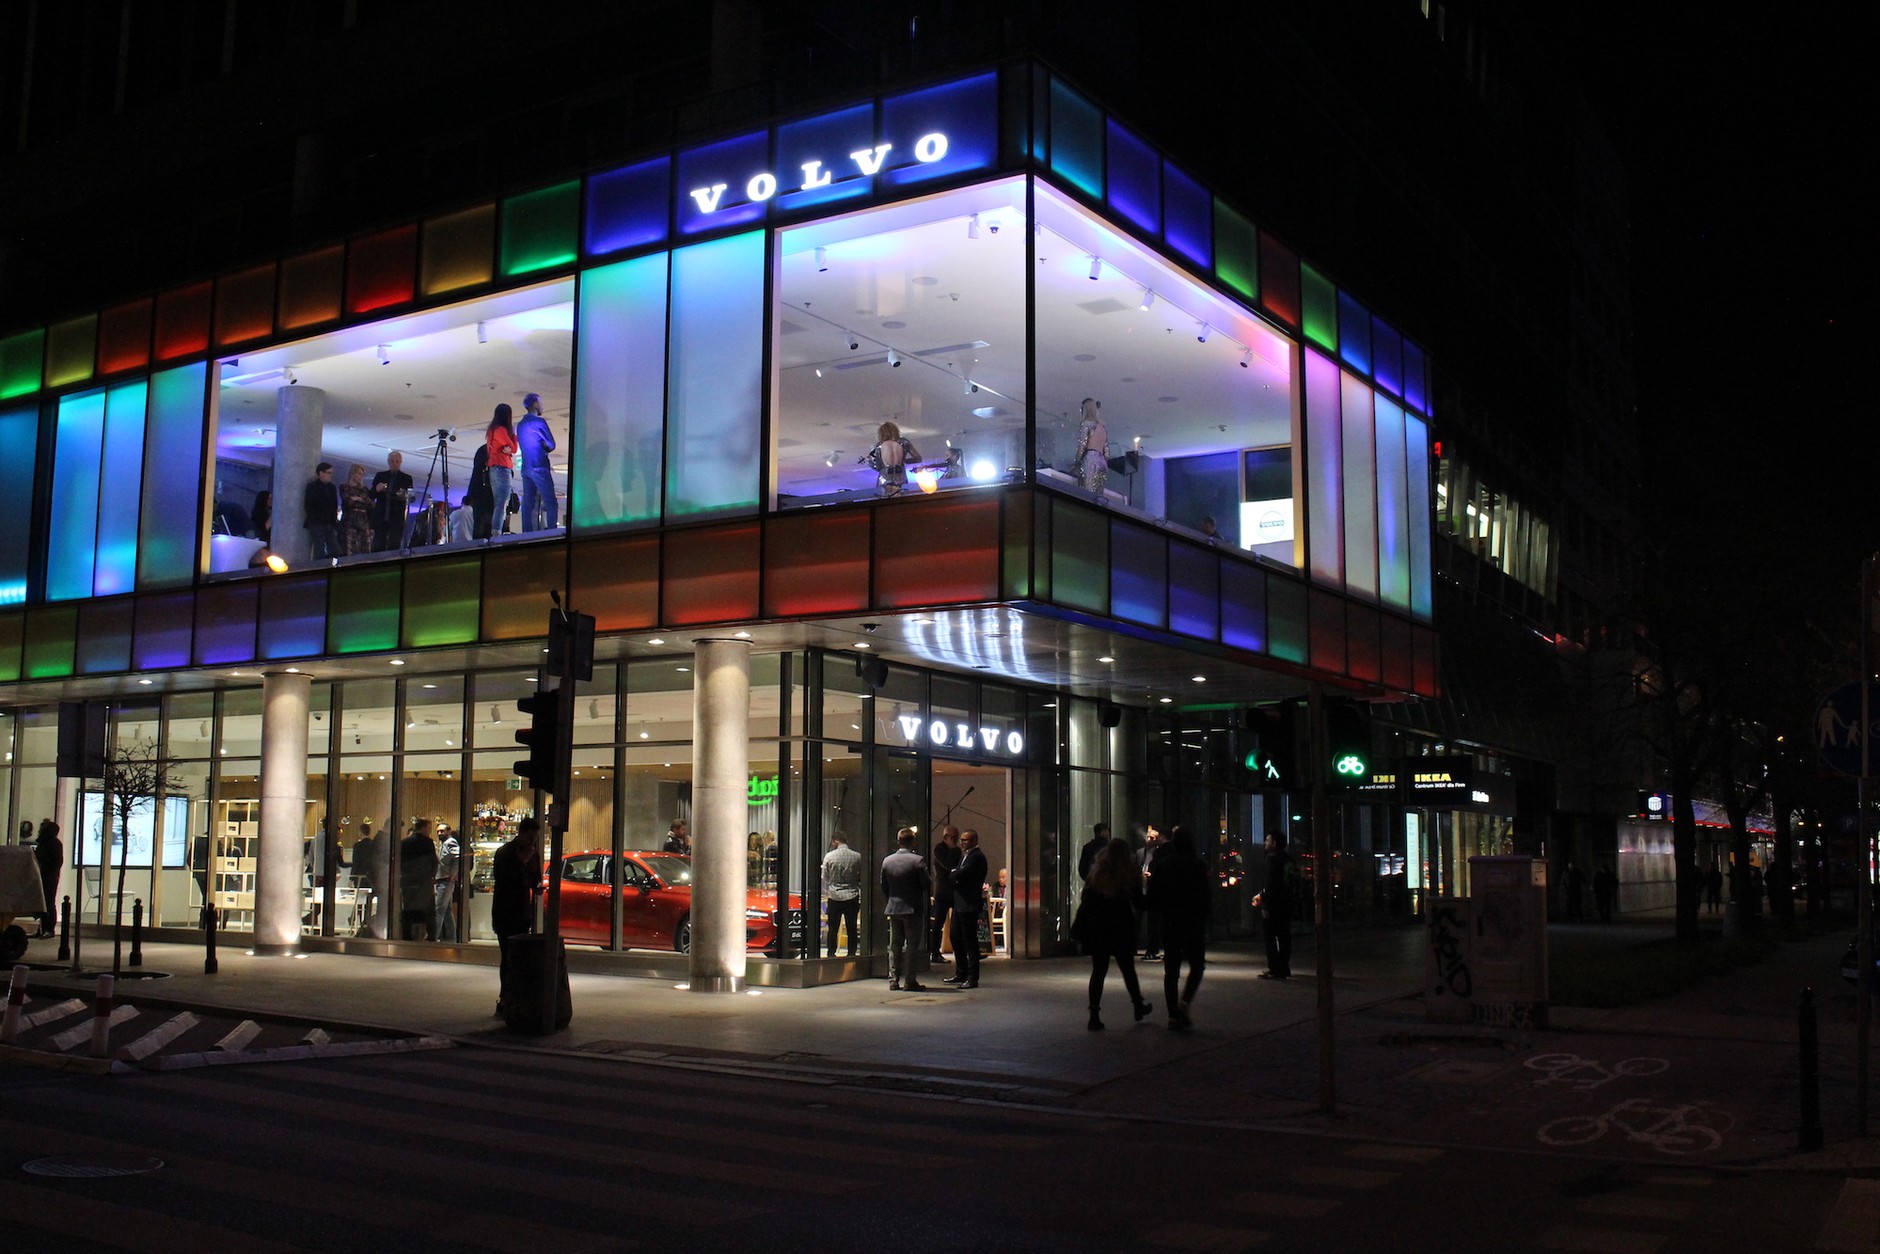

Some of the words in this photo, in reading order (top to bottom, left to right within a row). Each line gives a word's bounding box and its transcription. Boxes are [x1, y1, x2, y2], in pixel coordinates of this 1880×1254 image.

[690, 132, 949, 214] VOLVO
[898, 716, 1023, 754] VOLVO
[1414, 773, 1452, 782] IKEA
